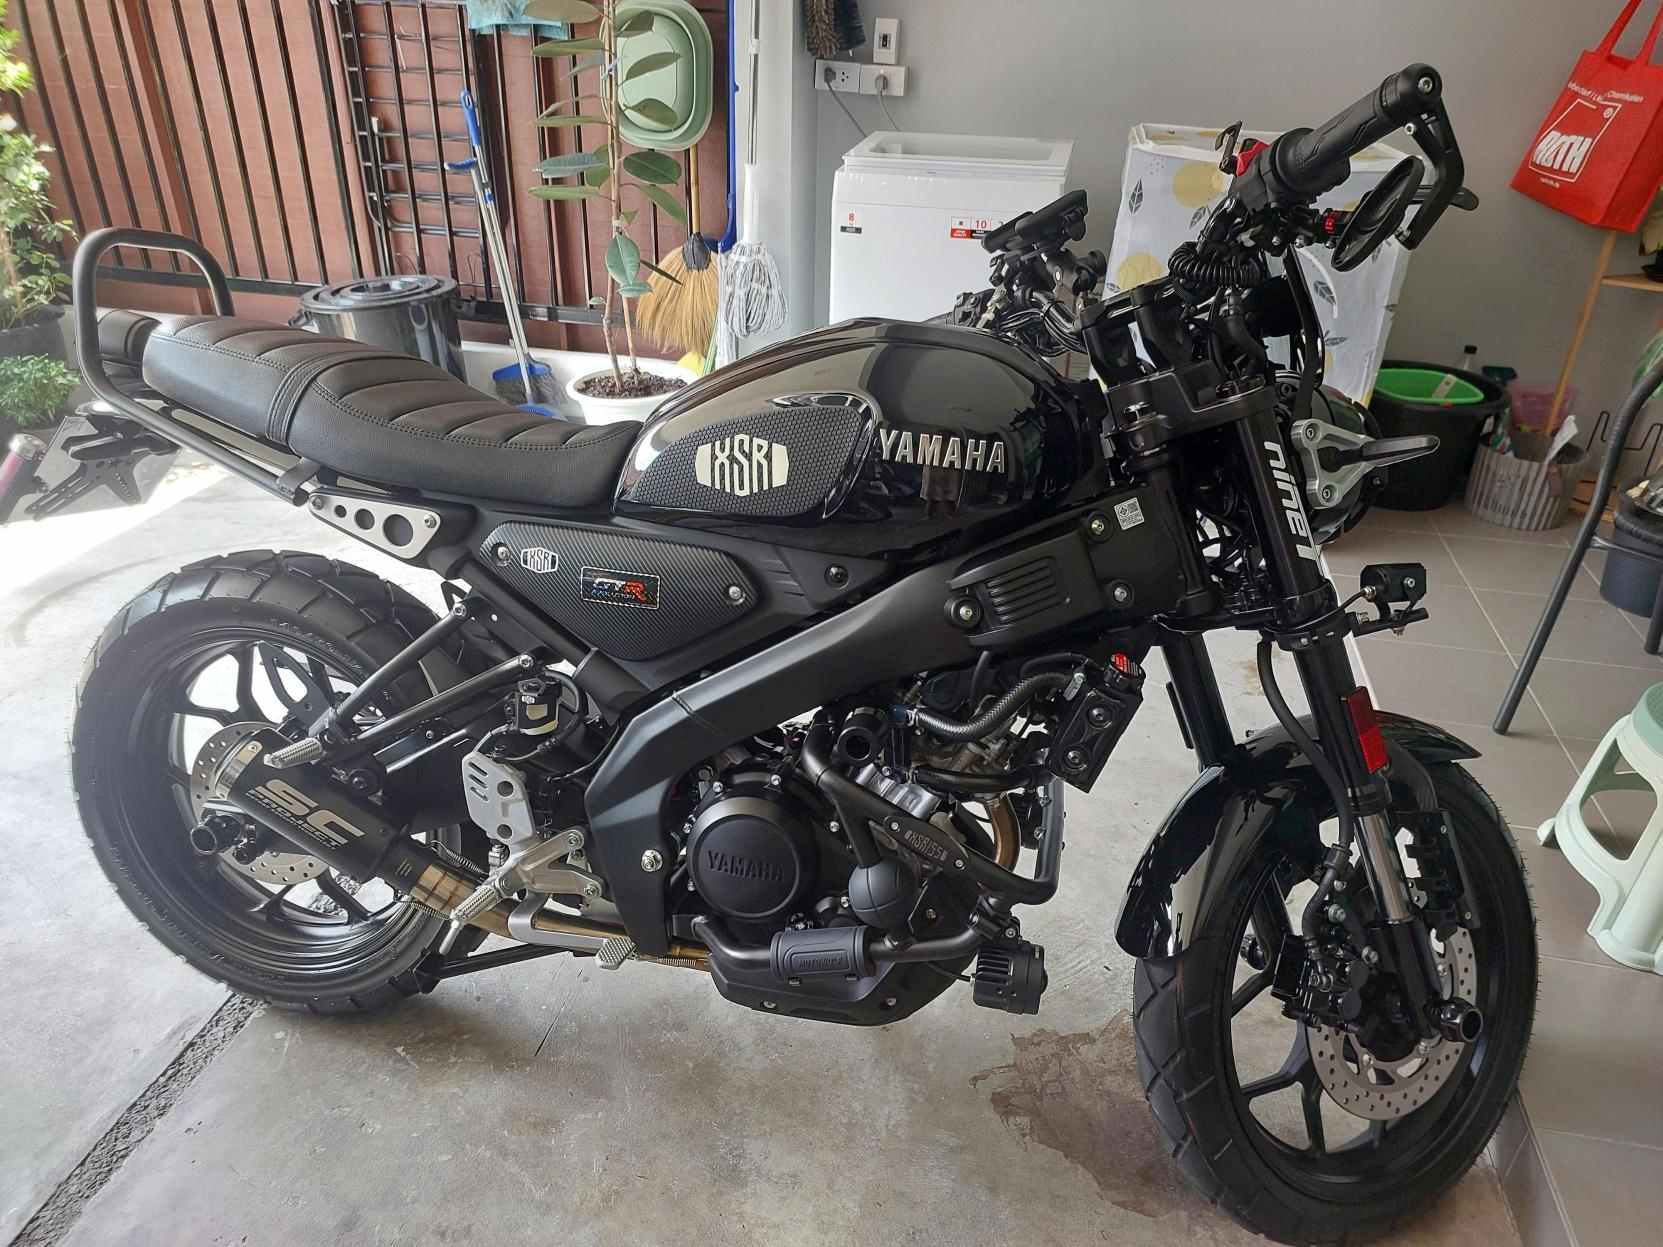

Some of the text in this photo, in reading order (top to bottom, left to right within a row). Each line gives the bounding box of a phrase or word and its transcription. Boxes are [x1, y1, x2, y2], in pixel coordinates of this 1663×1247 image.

[1532, 130, 1593, 173] ROTH
[975, 219, 987, 229] 10
[712, 433, 771, 497] XSR
[879, 427, 1005, 474] YAMAHA
[527, 547, 552, 573] XSR
[253, 778, 366, 845] SC
[706, 849, 785, 883] YAMAHA
